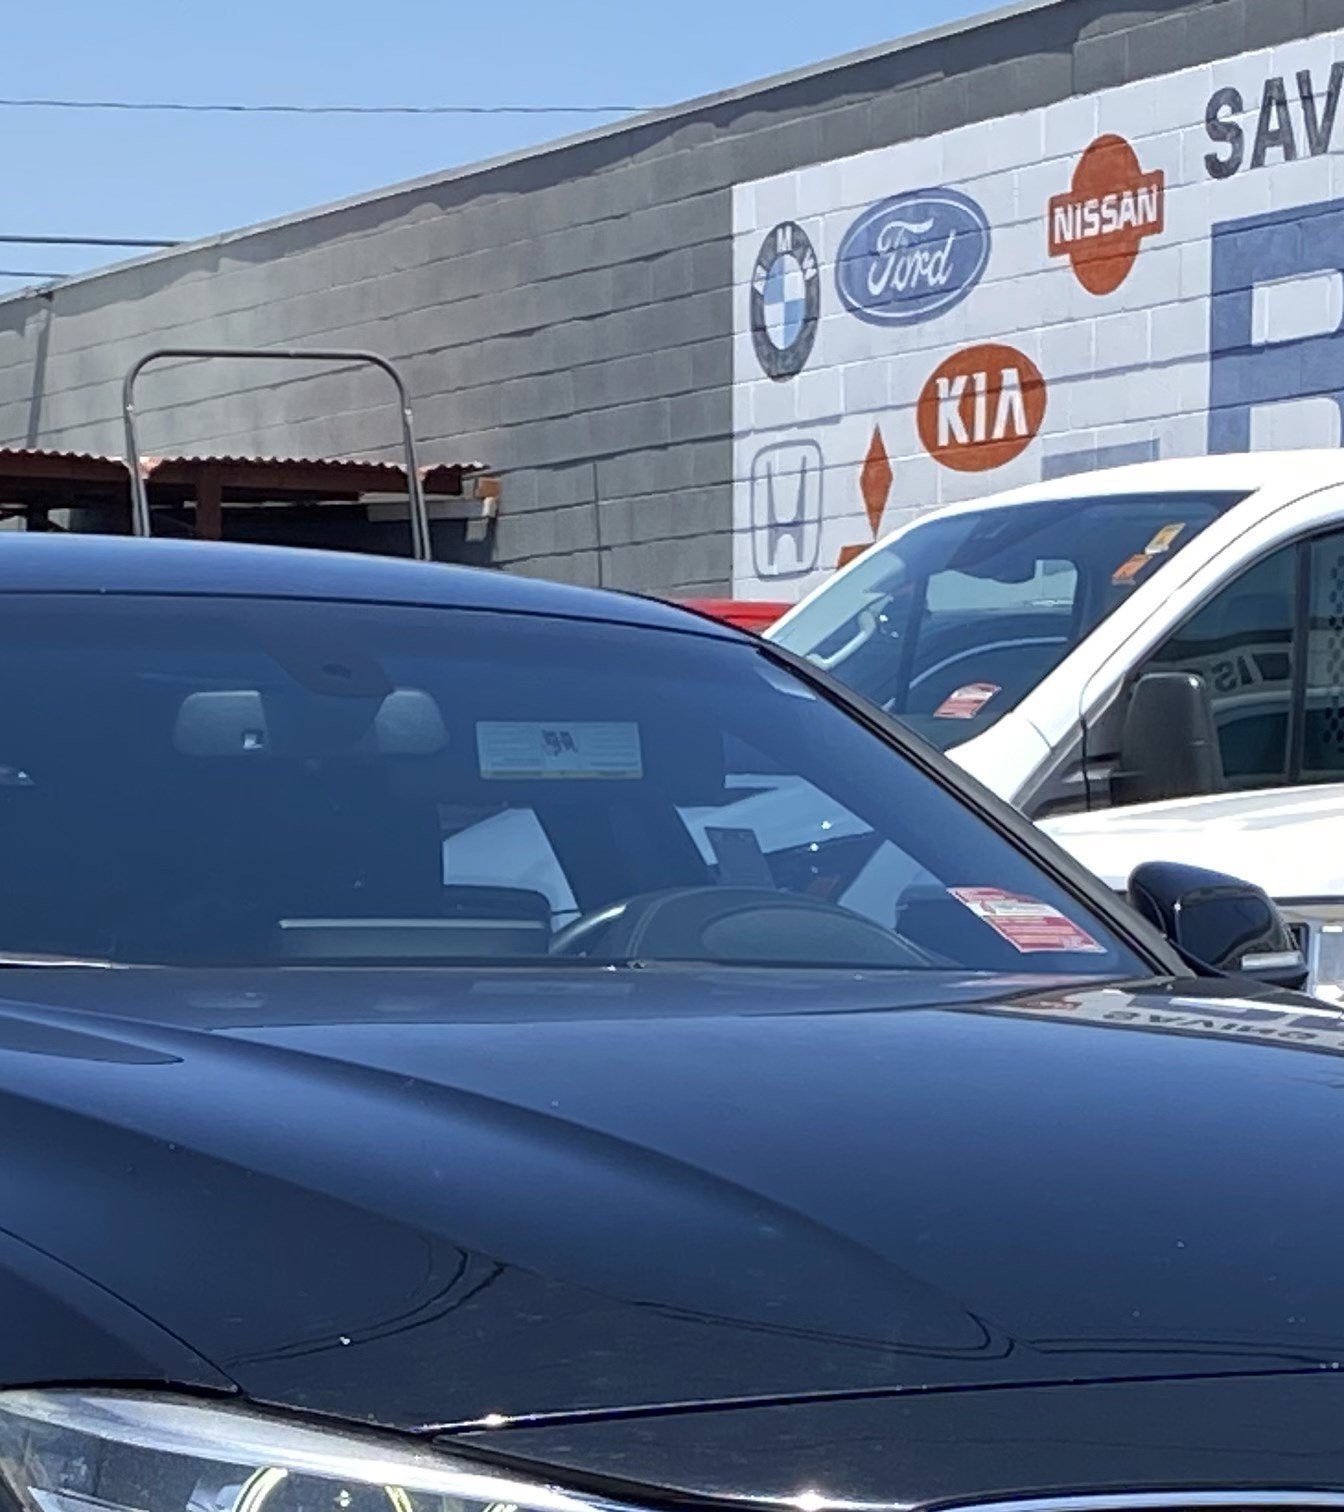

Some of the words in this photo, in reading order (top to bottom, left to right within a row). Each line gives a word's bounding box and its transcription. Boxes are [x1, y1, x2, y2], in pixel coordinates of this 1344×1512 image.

[1054, 182, 1159, 245] NISSAN
[866, 217, 956, 296] Ford
[936, 367, 1030, 448] KIA
